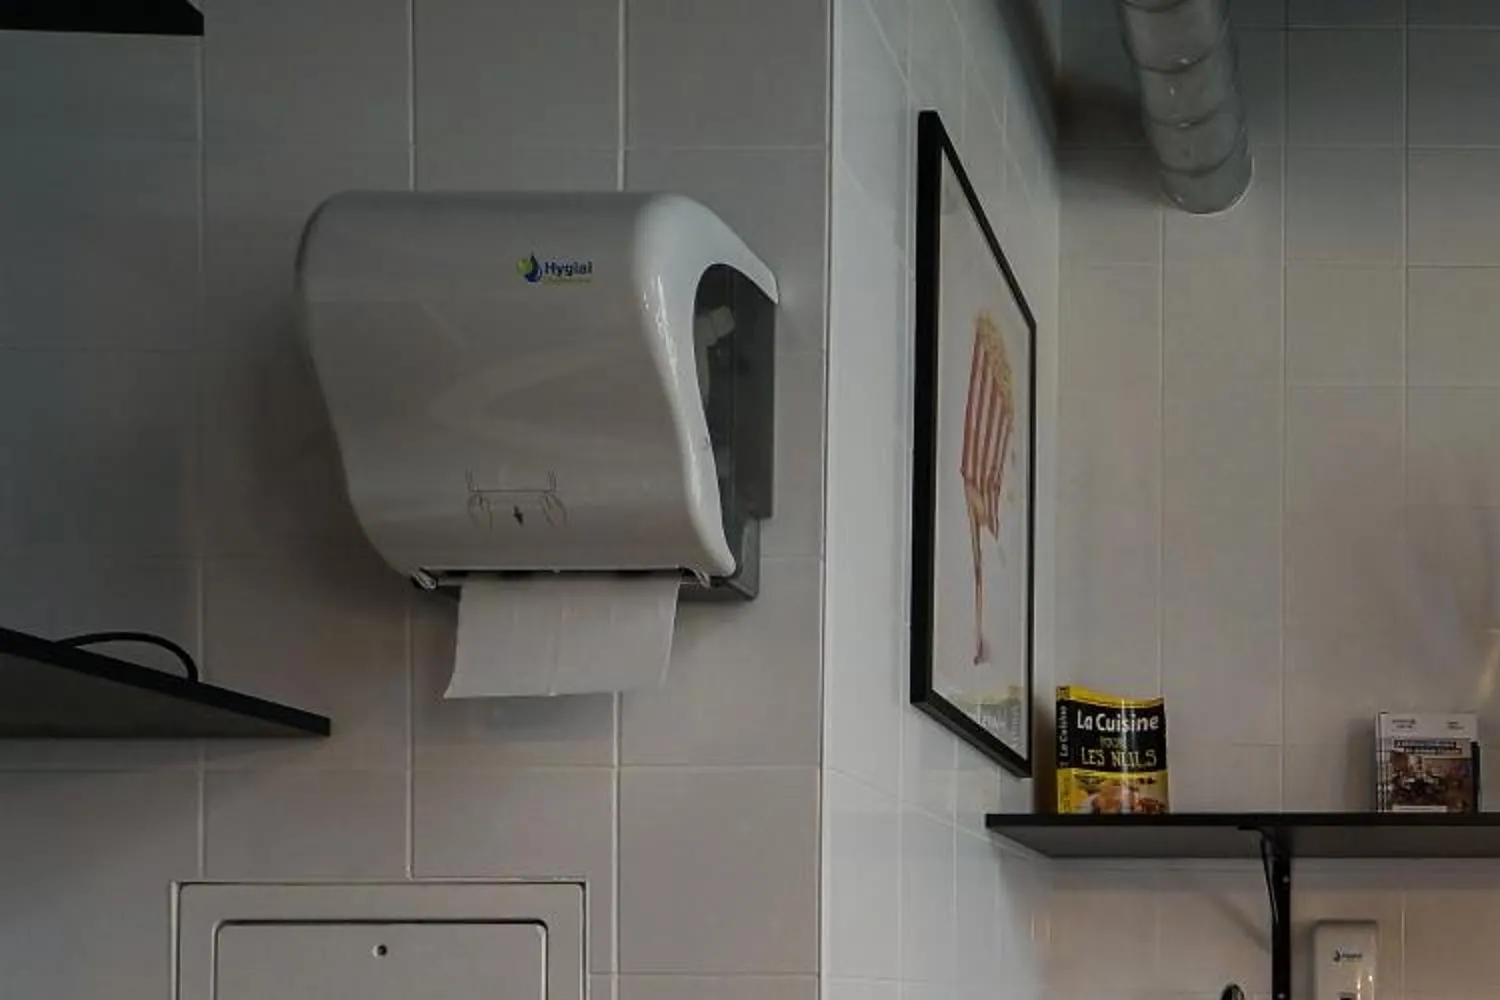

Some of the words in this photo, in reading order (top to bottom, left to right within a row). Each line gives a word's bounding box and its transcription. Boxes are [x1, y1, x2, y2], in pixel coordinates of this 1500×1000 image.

[1077, 709, 1093, 730] La
[1095, 713, 1159, 733] Cuisine
[1081, 747, 1105, 766] LES
